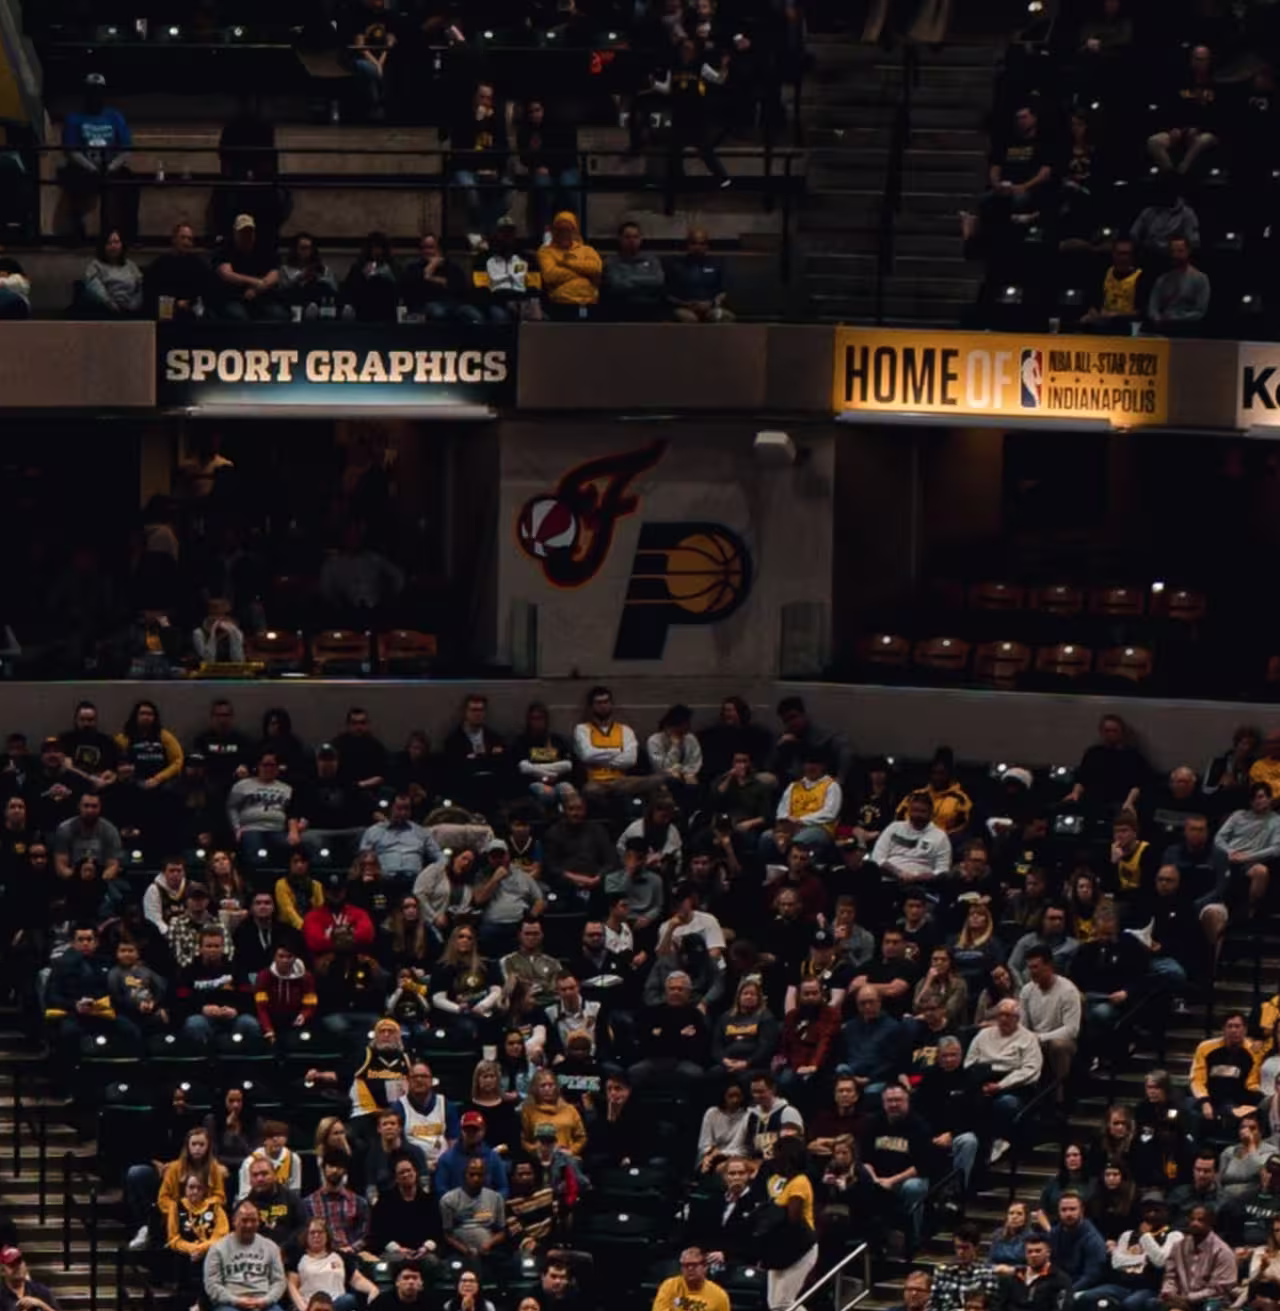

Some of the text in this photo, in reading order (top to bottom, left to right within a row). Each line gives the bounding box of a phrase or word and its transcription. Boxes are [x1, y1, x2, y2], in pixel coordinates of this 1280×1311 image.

[166, 349, 507, 383] SPORT GRAPHICS
[1048, 350, 1070, 372] NBA
[844, 345, 1012, 409] HOME OF
[1047, 386, 1156, 414] INDIANAPOLIS
